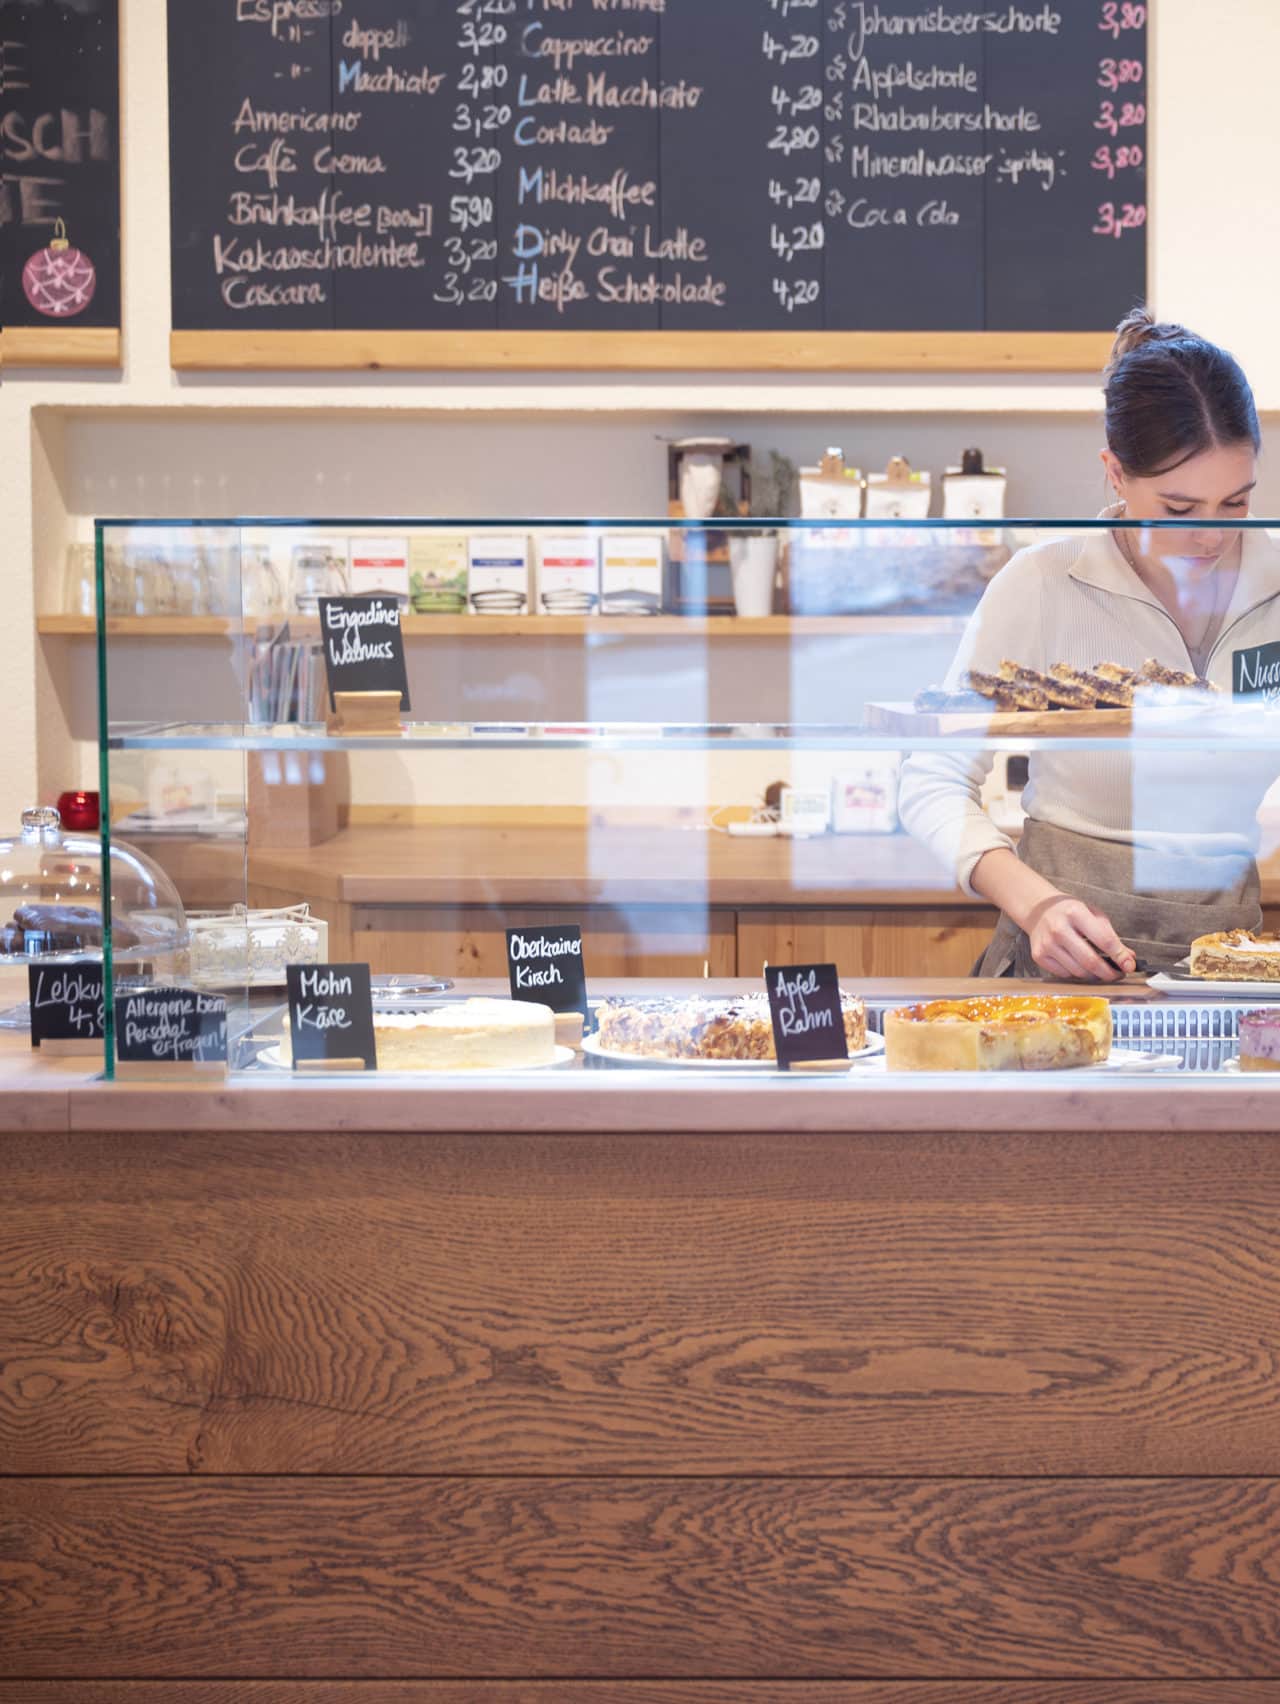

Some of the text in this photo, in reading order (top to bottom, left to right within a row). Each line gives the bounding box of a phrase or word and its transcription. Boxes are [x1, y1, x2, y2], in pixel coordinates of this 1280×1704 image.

[457, 21, 507, 56] 3,20
[522, 22, 819, 70] Cappuccino 4,20
[848, 2, 1060, 61] Johannisbeerschorle
[1097, 1, 1145, 40] 3,80
[339, 59, 447, 94] Macchiato
[457, 63, 508, 99] 2,80
[518, 71, 823, 117] Latte Macchiato 4,20
[852, 56, 977, 98] Apfelschorle
[1097, 58, 1143, 92] 3,80
[233, 98, 511, 138] Americano 3,20
[514, 116, 820, 156] Cortado 2,80
[852, 103, 1041, 131] Rhabarberschorle
[1093, 100, 1146, 136] 3,80
[313, 146, 387, 173] Crema
[449, 146, 501, 184] 3,20
[852, 144, 992, 178] Mineralwasser
[1090, 145, 1143, 179] 3,80
[518, 166, 821, 220] Milchkaffee 4,20
[450, 195, 493, 232] 5,90
[848, 198, 907, 228] Coca
[916, 200, 959, 227] Cola
[1092, 201, 1146, 238] 3,20
[214, 234, 498, 274] Kakaoschalentee 3,20
[512, 221, 824, 270] Dirty Chai Latte 4,20
[221, 272, 498, 309] Cascara 3,20
[597, 265, 727, 306] Schokolade
[773, 278, 819, 312] 4,20
[326, 600, 400, 646] Engadiner
[510, 934, 582, 961] Oberkrainer
[34, 971, 105, 1008] Lebku
[300, 970, 352, 998] Mohn
[516, 963, 564, 989] Kirsch
[775, 970, 820, 1012] Apfel
[126, 994, 226, 1030] Allergene beim
[126, 1017, 190, 1047] Personal
[780, 1006, 833, 1037] Rahm
